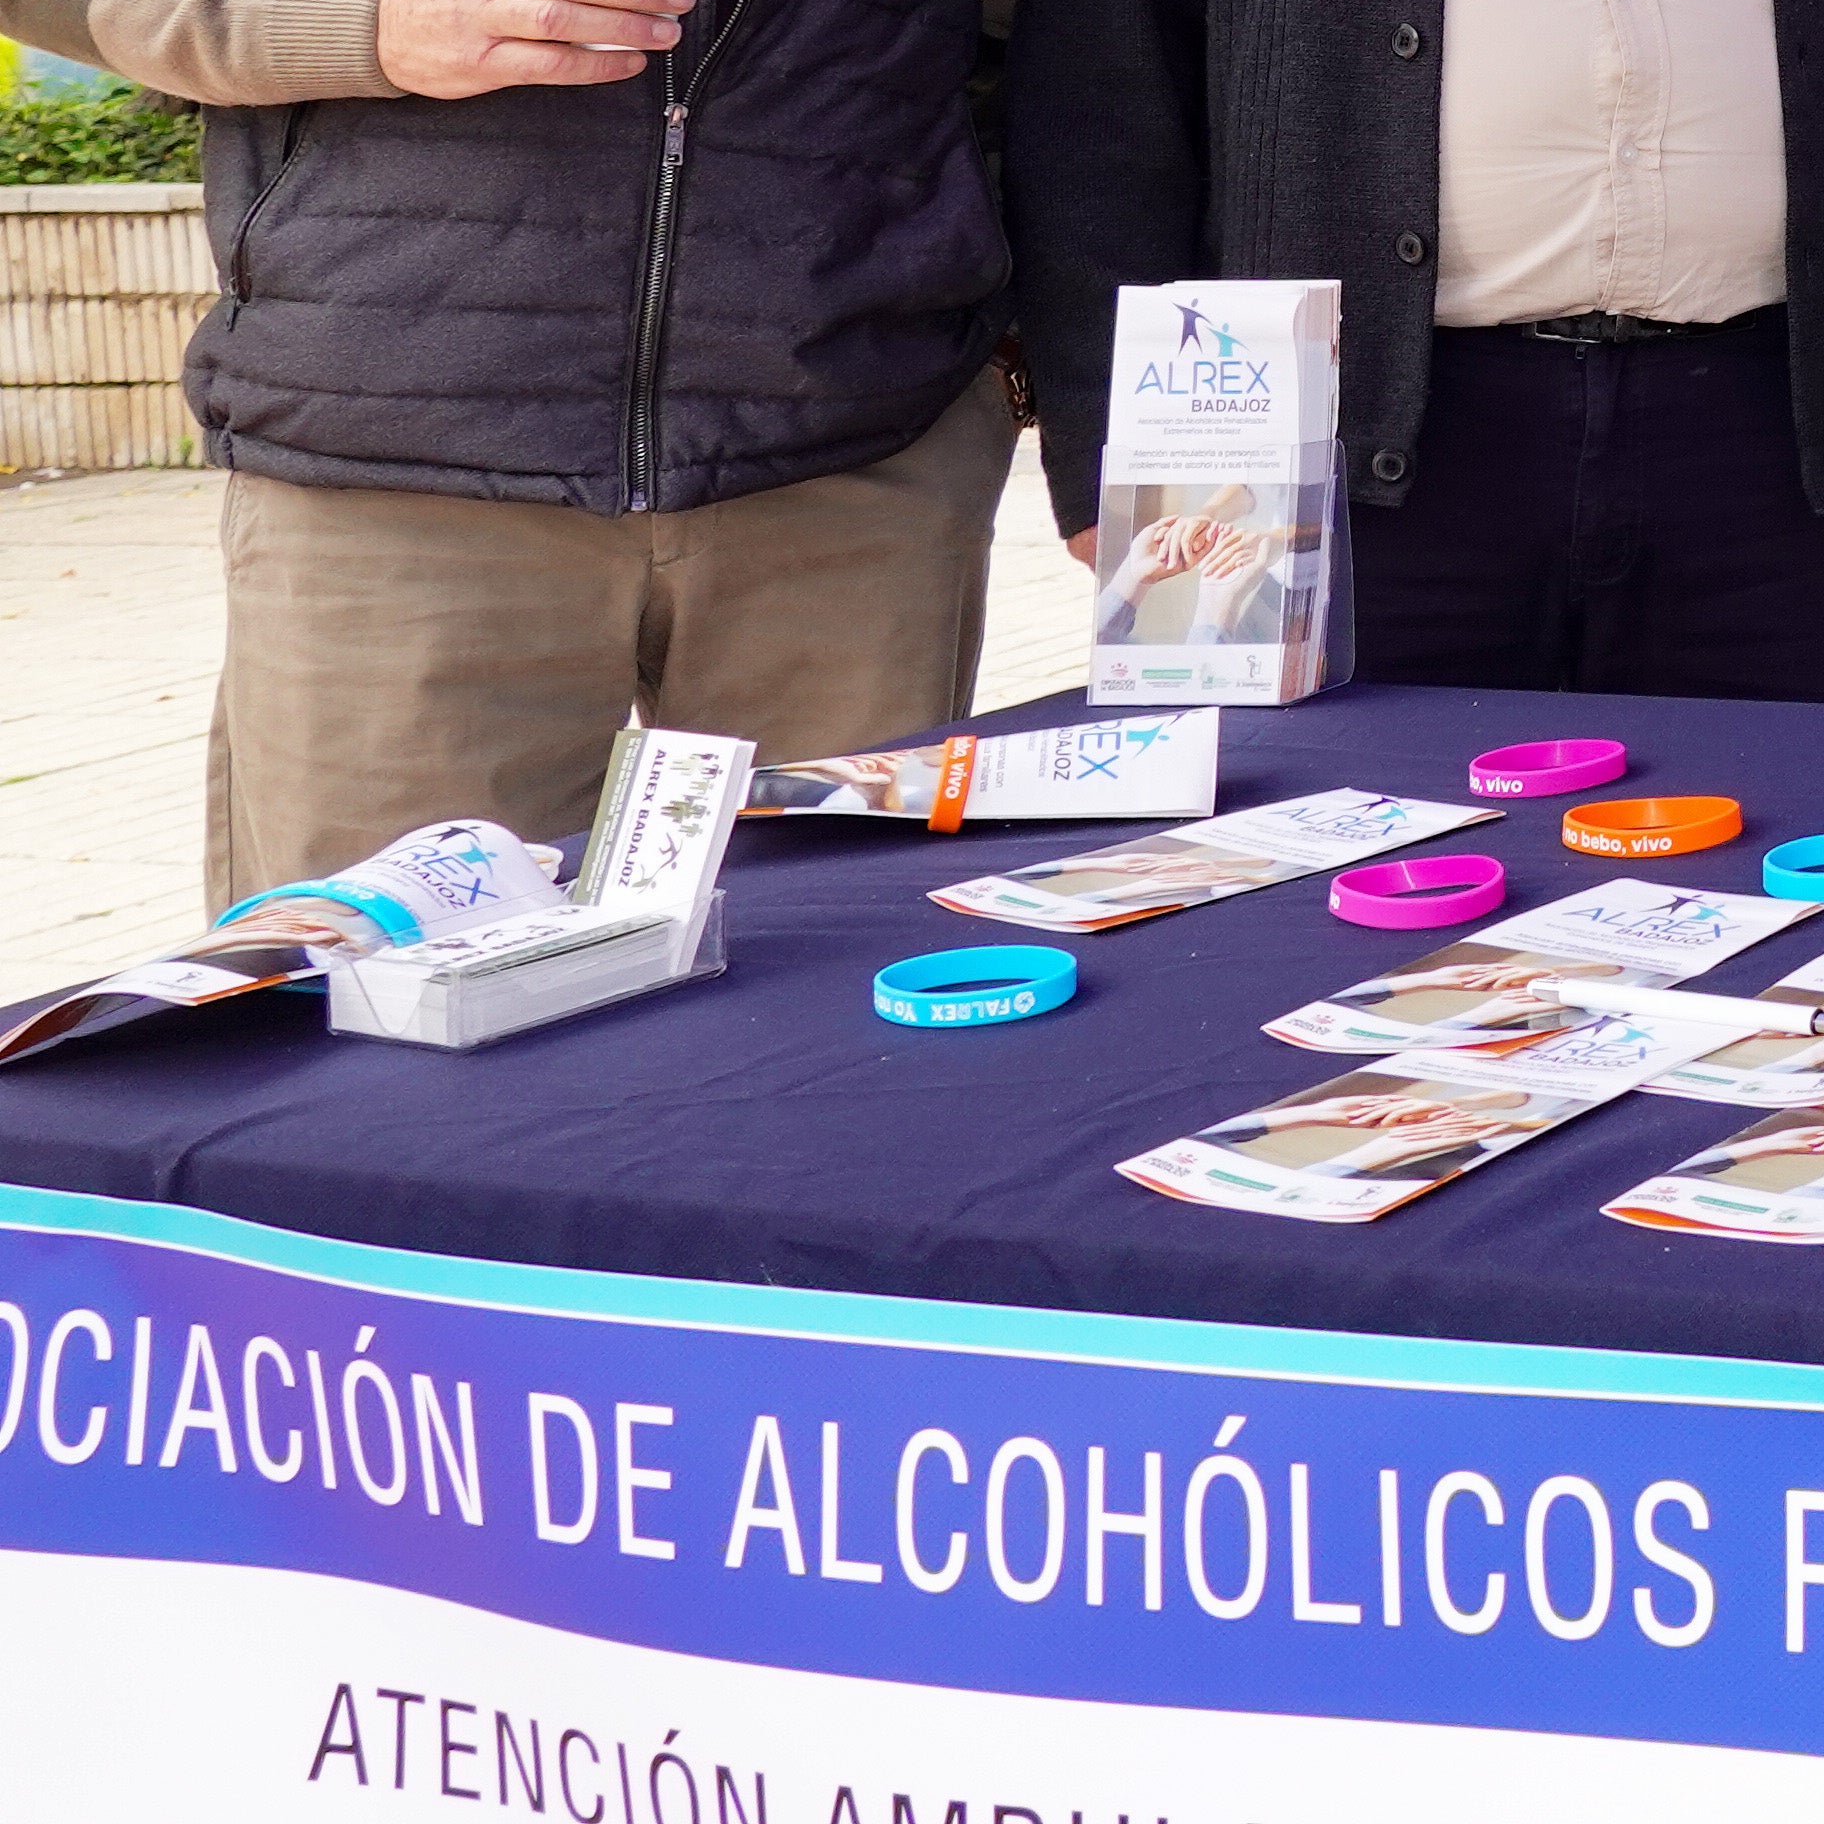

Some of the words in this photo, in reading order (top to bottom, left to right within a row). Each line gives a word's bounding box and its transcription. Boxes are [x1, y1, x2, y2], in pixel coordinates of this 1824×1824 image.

[1134, 361, 1271, 395] ALREX
[1191, 398, 1271, 413] BADAJOZ
[647, 749, 667, 802] ALREX
[945, 761, 967, 800] vivo
[1486, 776, 1523, 793] vivo
[618, 809, 651, 888] BADAJOZ
[1565, 828, 1577, 844] no
[1581, 828, 1626, 856] bebo,
[1631, 836, 1673, 853] vivo
[1562, 906, 1741, 943] ALREX
[1614, 926, 1712, 949] BADAJOZ
[894, 1001, 917, 1023] Yo
[930, 997, 1010, 1022] FALREX
[0, 1298, 485, 1528] CIACIÓN
[526, 1389, 678, 1561] DE
[723, 1411, 1717, 1648] ALCOHÓLICOS
[305, 1681, 768, 1824] ATENCIÓN
